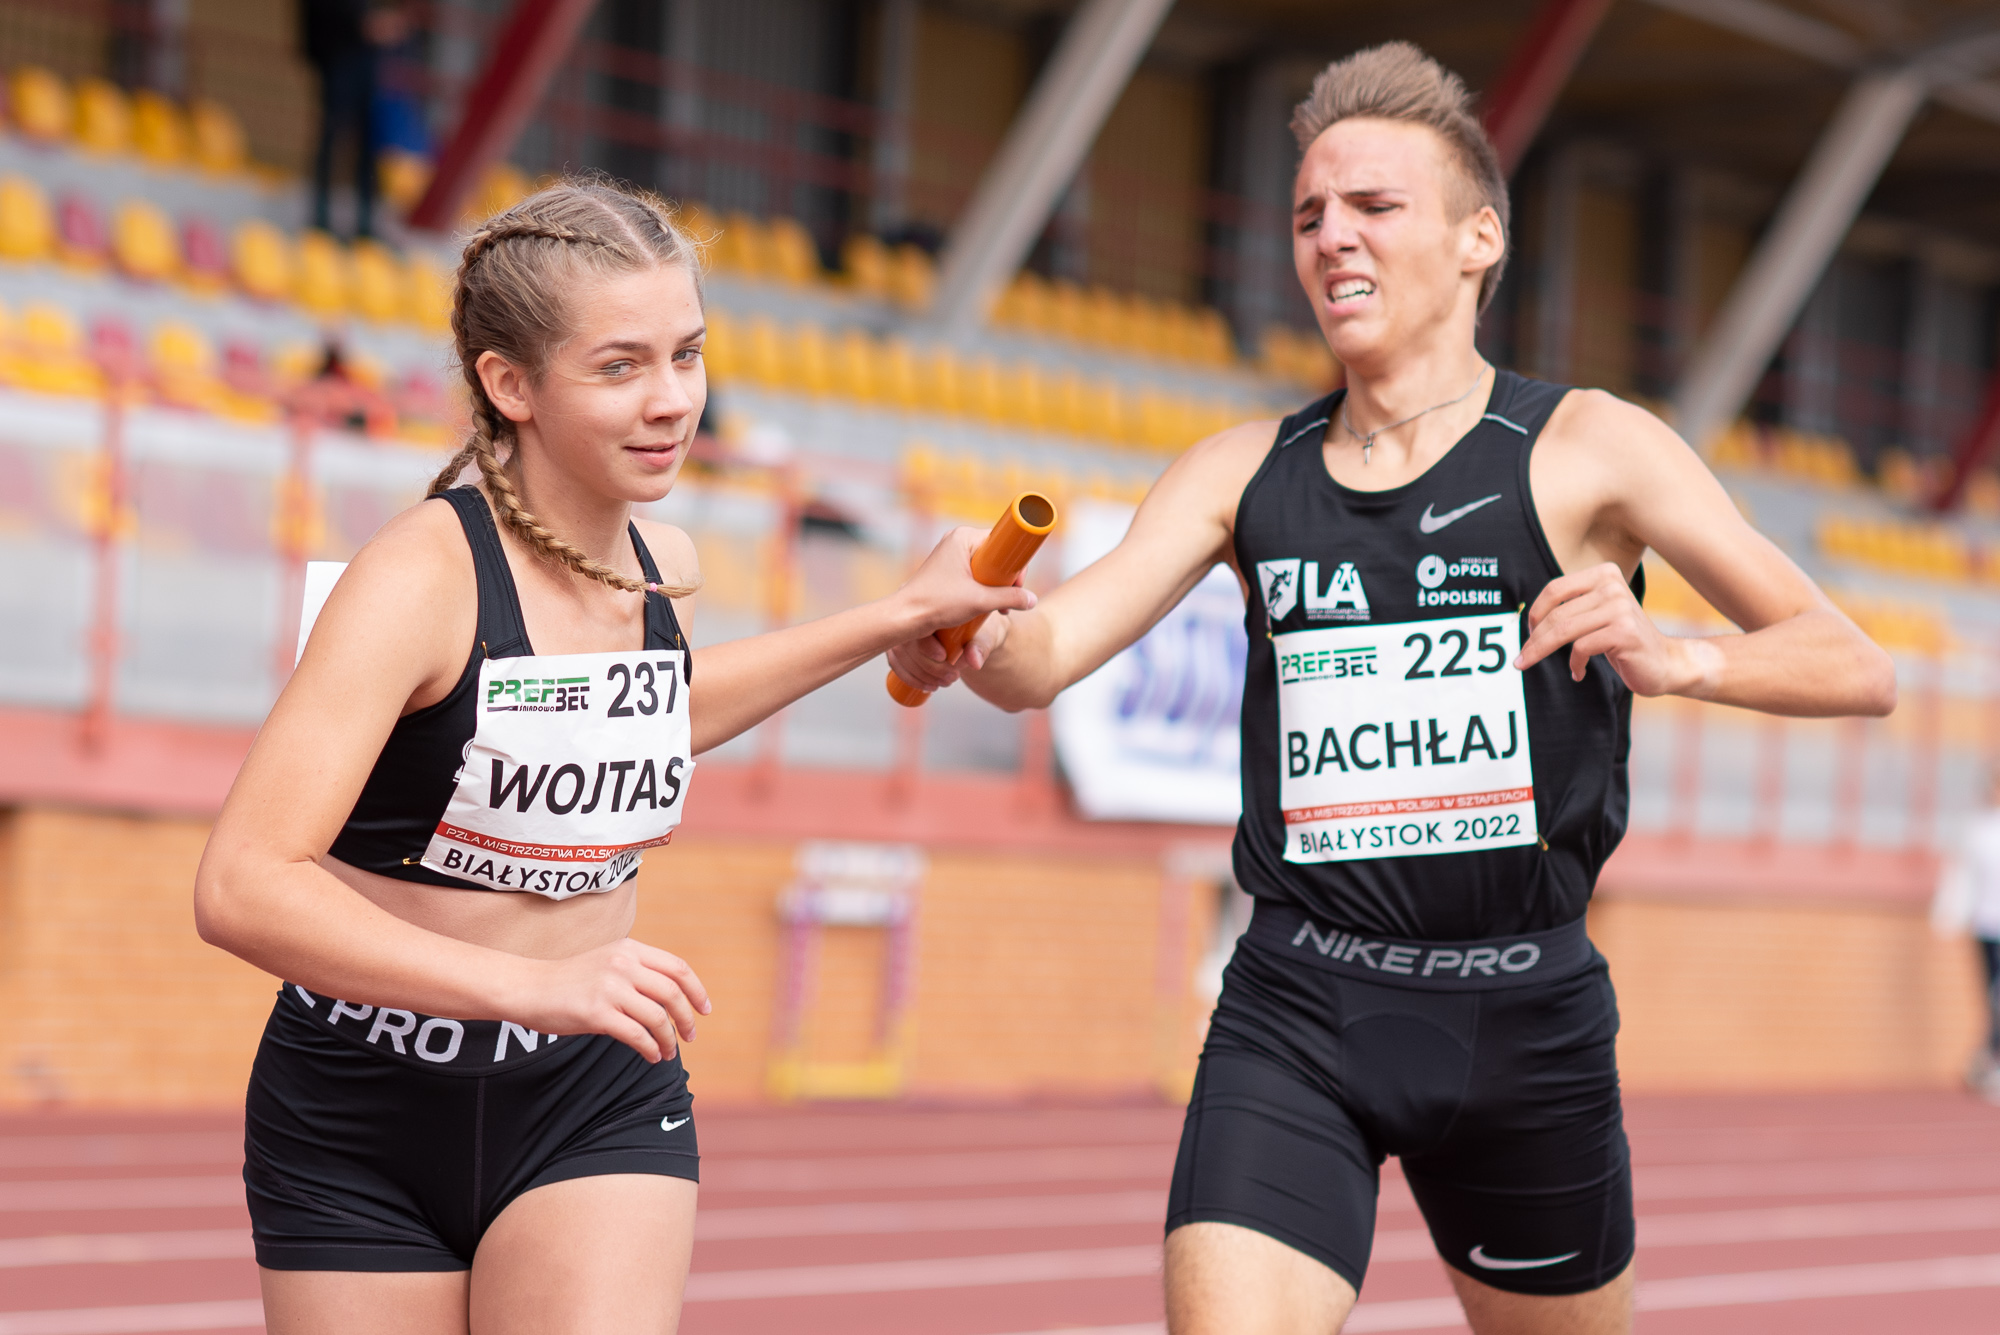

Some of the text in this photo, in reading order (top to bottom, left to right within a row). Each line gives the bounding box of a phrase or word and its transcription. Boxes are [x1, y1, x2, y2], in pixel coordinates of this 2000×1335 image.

[1304, 561, 1370, 609] LA
[1449, 563, 1498, 577] OPOLE
[1427, 590, 1502, 606] OPOLSKIE
[1403, 626, 1507, 680] 225
[607, 661, 678, 718] 237
[1287, 711, 1519, 779] BACHŁAJ
[489, 757, 684, 815] WOJTAS
[1314, 802, 1395, 818] MISTRZOSTWA
[1397, 799, 1440, 811] POLSKI
[1443, 799, 1455, 808] W
[1457, 789, 1529, 807] SZTAFETACH
[446, 828, 481, 845] PZLA
[483, 838, 574, 858] MISTRZOSTWA
[1300, 814, 1521, 854] BIAŁYSTOK 2022
[443, 848, 607, 893] BIAŁYSTOK
[1291, 920, 1541, 978] NIKE PRO
[327, 999, 465, 1063] PRO
